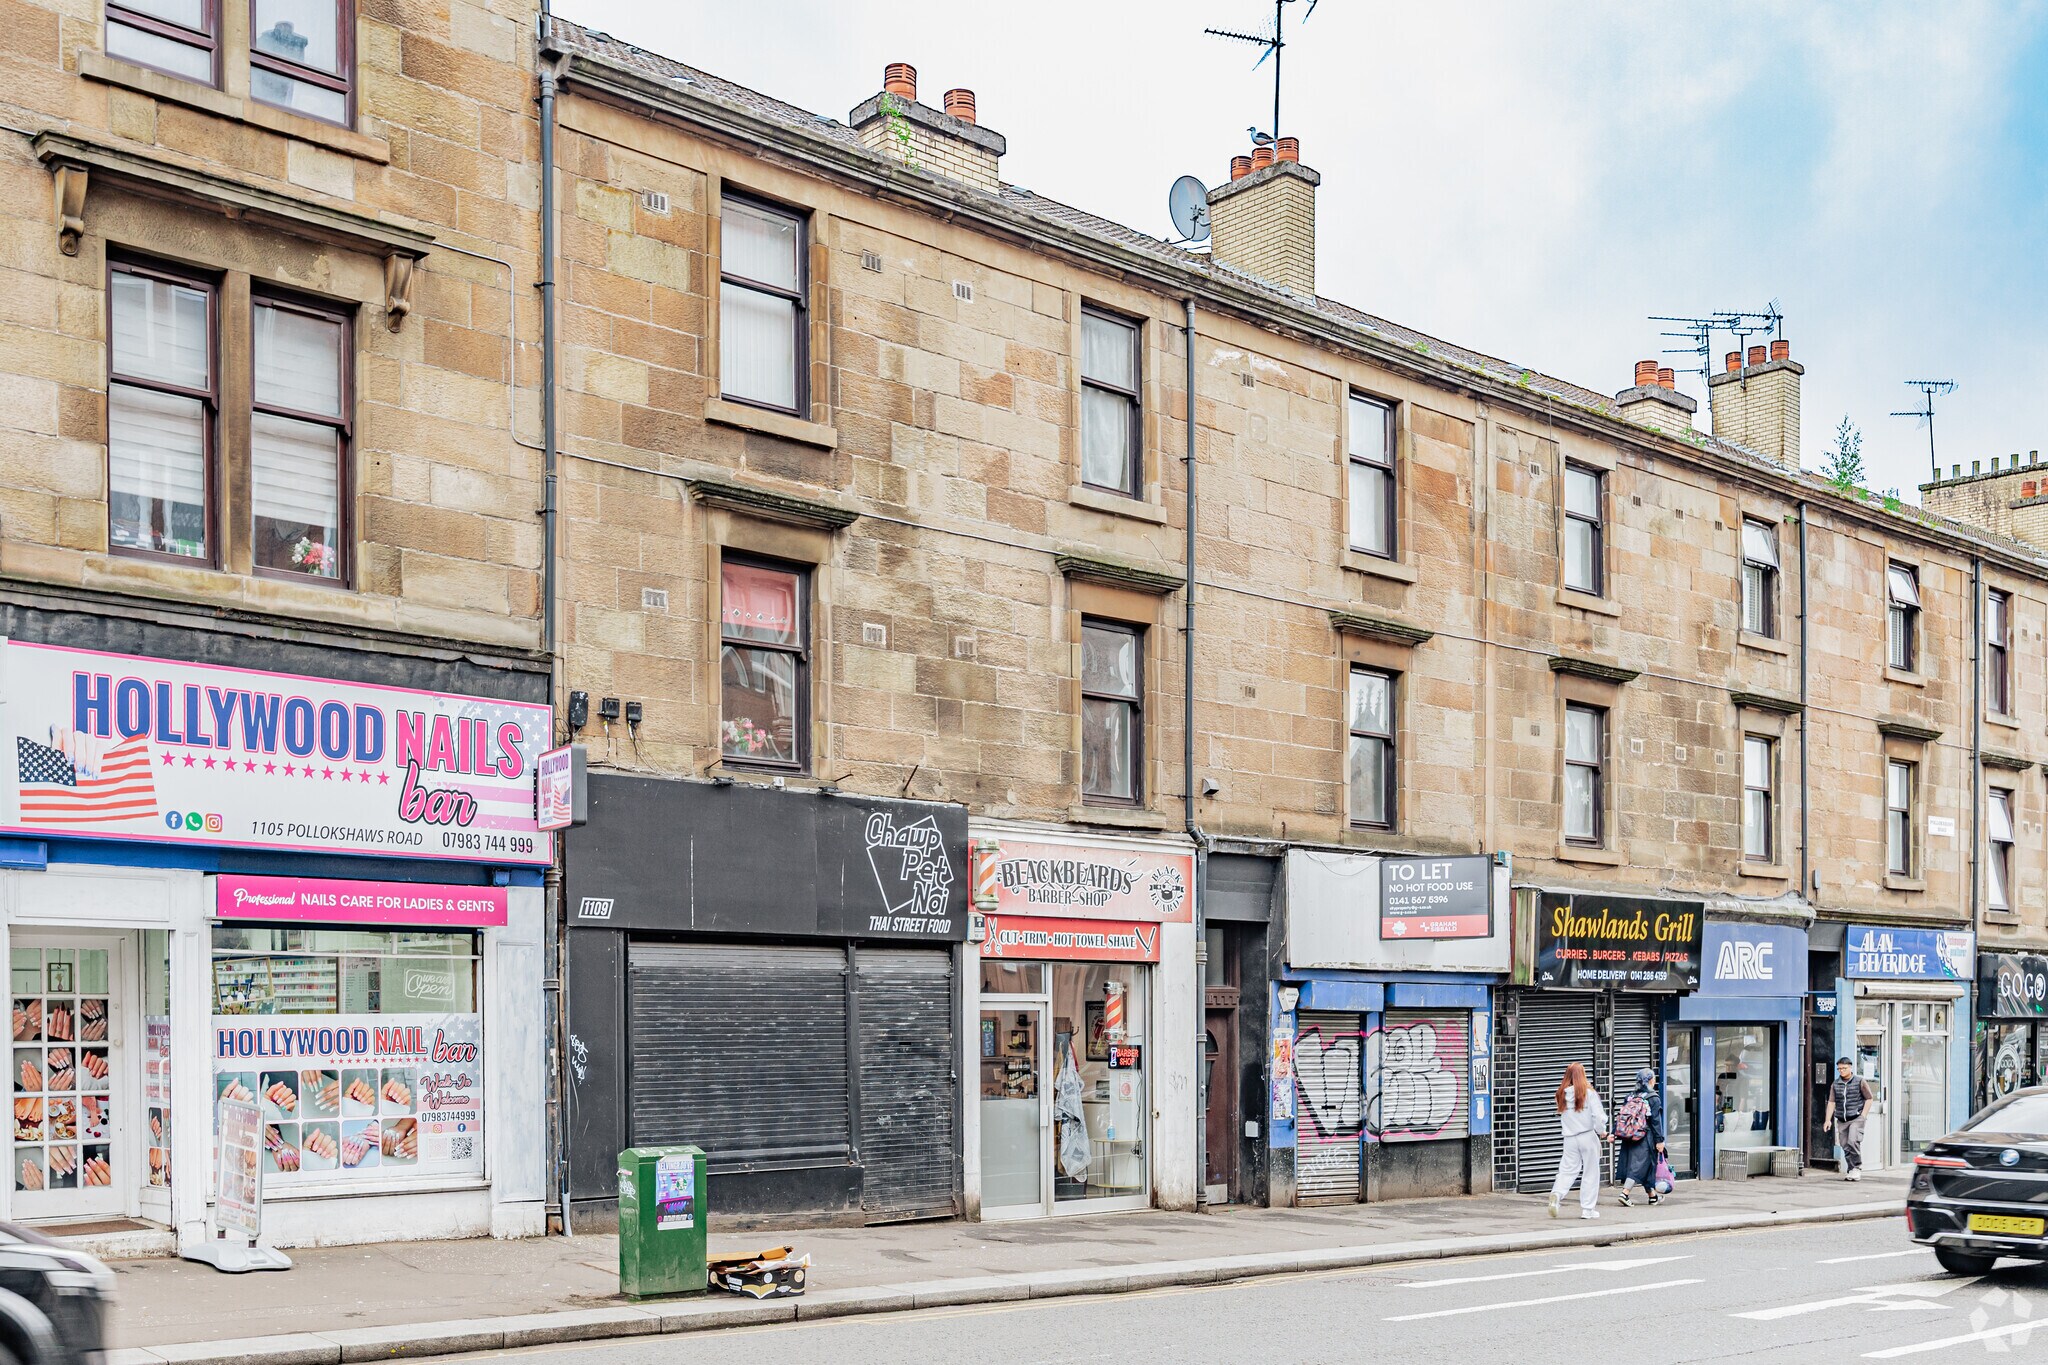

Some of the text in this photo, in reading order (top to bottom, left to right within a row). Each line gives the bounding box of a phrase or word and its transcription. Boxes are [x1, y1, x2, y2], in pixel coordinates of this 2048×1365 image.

[72, 670, 524, 779] HOLLYWOOD NAILS
[398, 759, 478, 827] bar
[252, 821, 423, 846] 1105 POLLOKSHAWS ROAD
[442, 831, 533, 854] 07983 744 999
[865, 812, 942, 858] Chawp
[900, 848, 947, 890] Pet
[1000, 859, 1132, 895] BLACKBEARDS
[1151, 866, 1183, 883] BLACK
[1389, 863, 1452, 881] TO LET
[910, 881, 949, 915] Noi
[1389, 881, 1473, 893] NO HOT FOOD USE
[233, 886, 495, 912] Professional NAILS CARE FOR LADIES & GENTS
[585, 900, 609, 915] 1109
[1150, 892, 1184, 913] BEARDS
[1389, 895, 1448, 905] 0141 567 5396
[869, 916, 951, 933] THAI STREET FOOD
[1551, 905, 1695, 943] Shawlands Grill
[1000, 930, 1136, 948] CUT TRIM HOT TOWEL SHAVE
[1859, 930, 1894, 953] ALAN
[1555, 948, 1688, 963] CURRIES BURGERS KEBABS PIZZAS
[1714, 940, 1773, 980] ARC
[1859, 953, 1927, 975] BEVERIDGE
[407, 974, 453, 998] Open
[1577, 970, 1668, 981] HOME DELIVERY 0141 286 4159
[217, 1026, 478, 1063] HOLLYWOOD NAIL bar
[1116, 1048, 1139, 1058] BARBER
[1119, 1057, 1135, 1066] SHOP
[423, 1089, 470, 1110] Welcome
[422, 1111, 476, 1122] 07983744999
